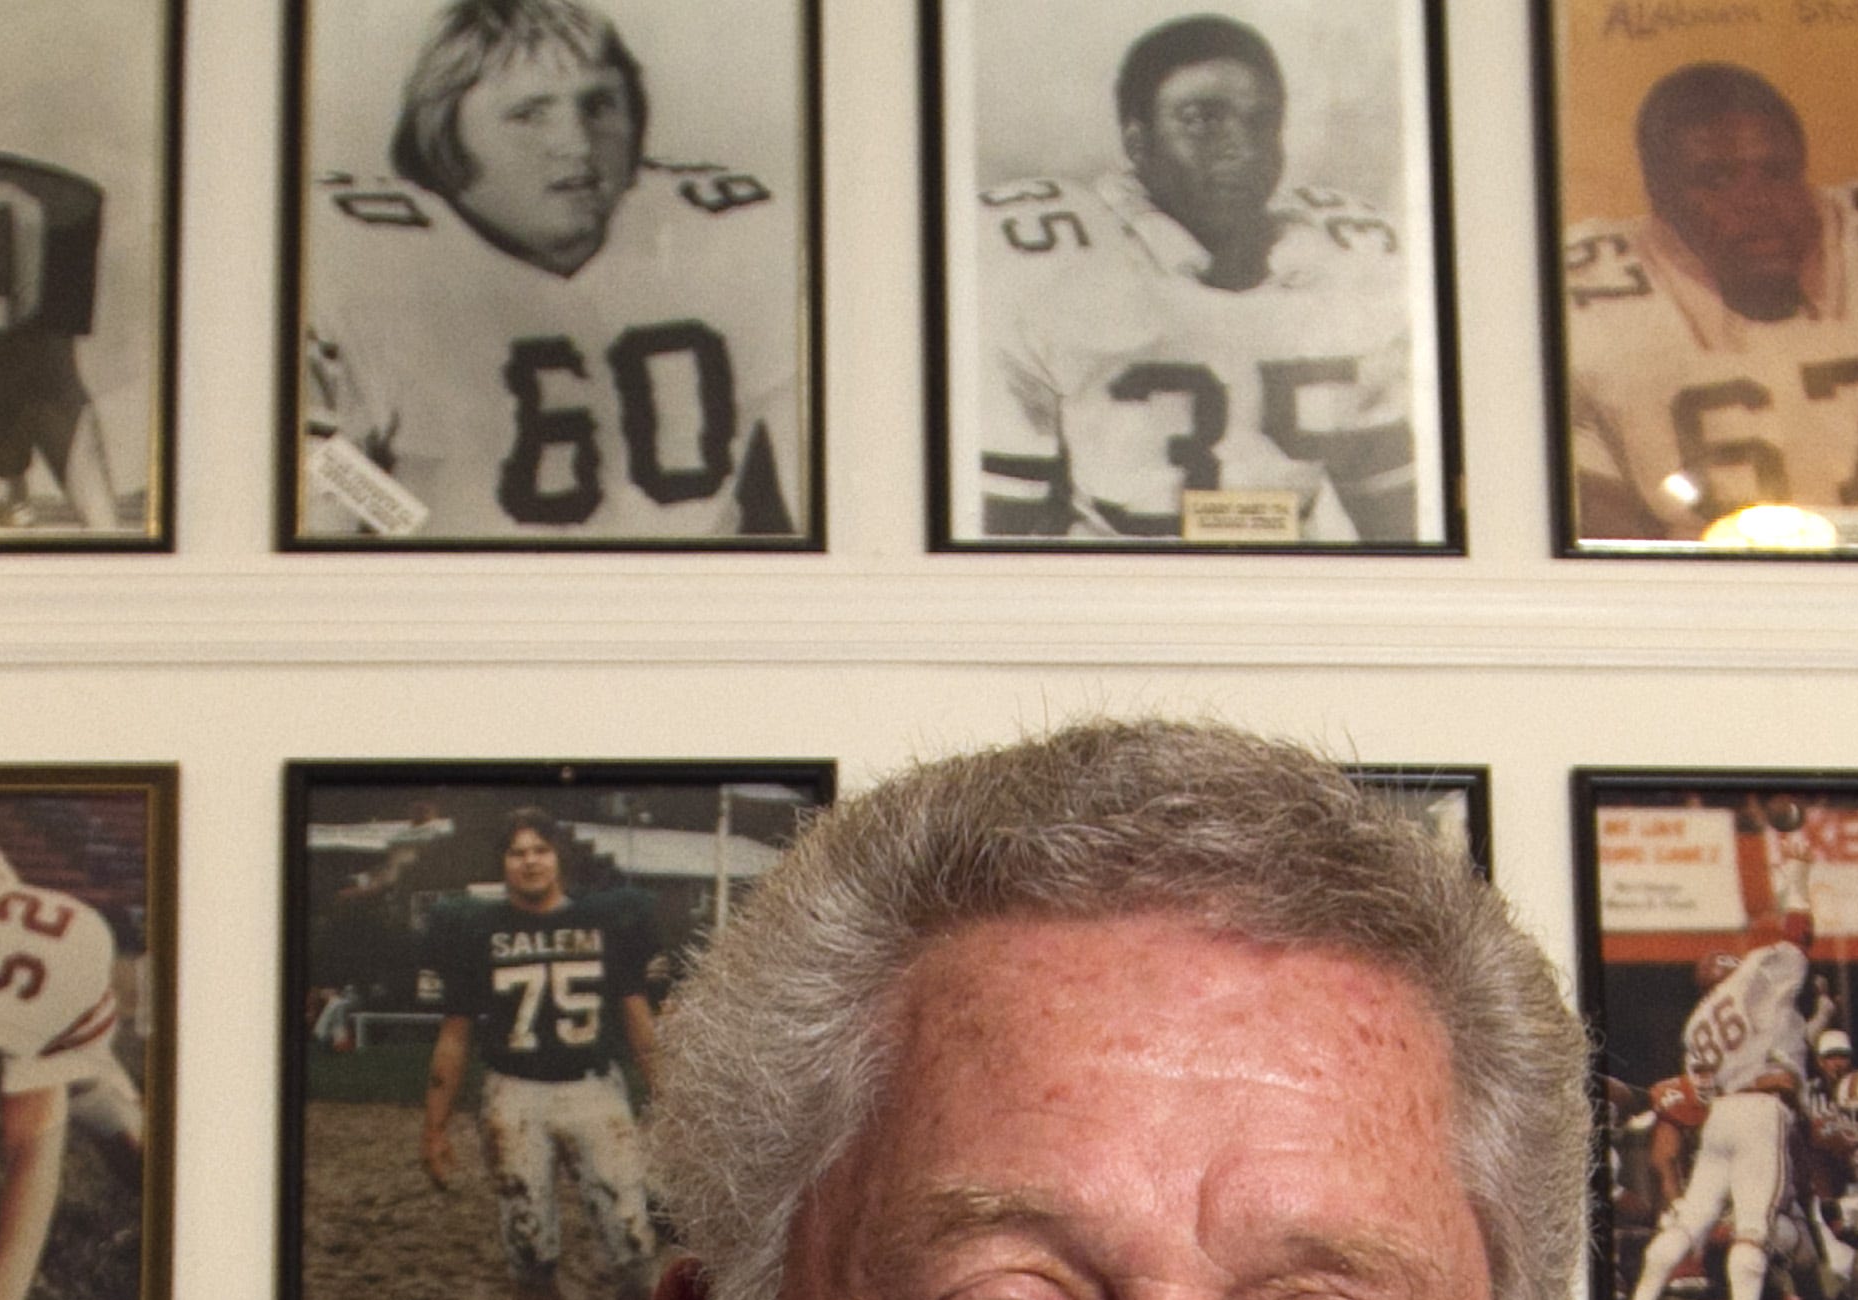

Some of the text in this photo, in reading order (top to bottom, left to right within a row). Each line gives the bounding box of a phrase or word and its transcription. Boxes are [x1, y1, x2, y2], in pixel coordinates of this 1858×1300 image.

[497, 320, 739, 526] 60
[1108, 360, 1387, 492] 35
[491, 928, 603, 957] SALEM
[493, 960, 604, 1050] 75
[1690, 997, 1749, 1074] 86
